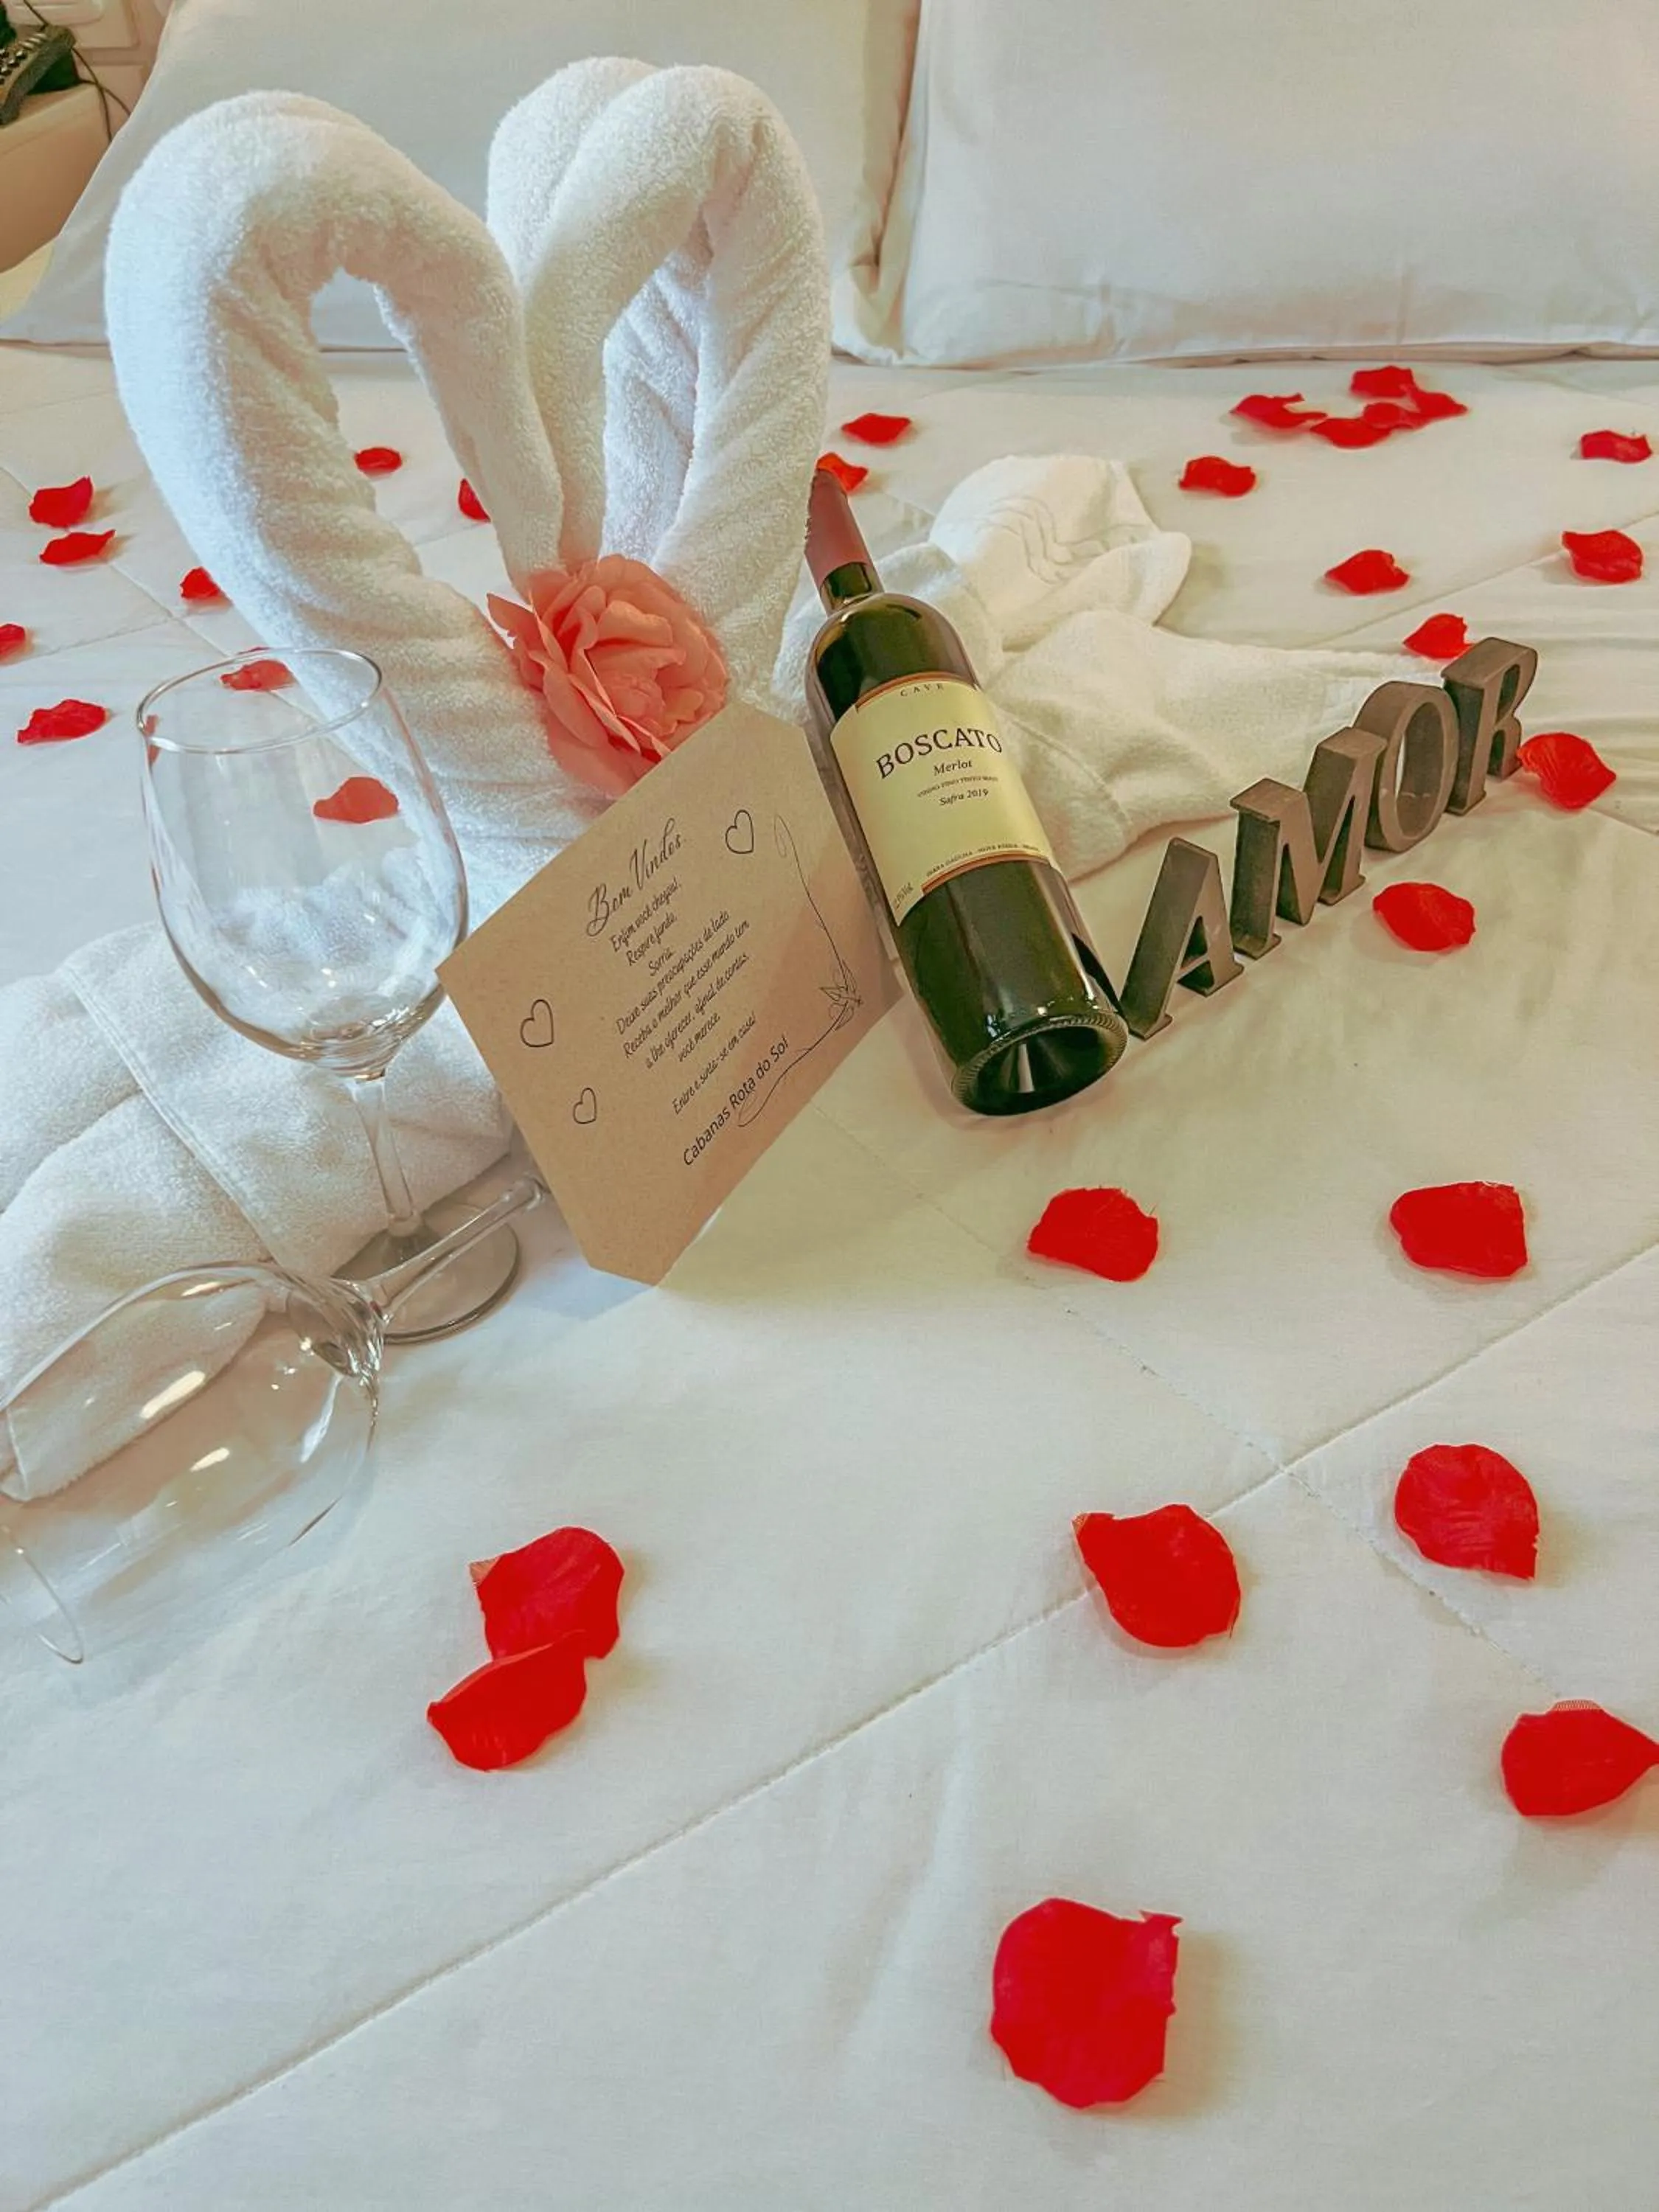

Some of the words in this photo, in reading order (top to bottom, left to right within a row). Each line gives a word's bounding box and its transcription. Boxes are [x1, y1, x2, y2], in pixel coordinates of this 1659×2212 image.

[876, 727, 1003, 779] BOSCATO
[933, 759, 973, 776] Merlot
[938, 794, 964, 807] Safra
[967, 787, 990, 799] 2019
[1121, 636, 1538, 1042] AMOR
[616, 1006, 641, 1035] Deixe
[640, 989, 658, 1012] suas
[656, 937, 705, 997] preocupações
[703, 926, 714, 942] de
[622, 1024, 653, 1059] Receba
[651, 1018, 659, 1029] o
[657, 990, 682, 1023] melhor
[683, 975, 698, 998] que
[696, 958, 713, 980] esse
[711, 933, 736, 964] mundo
[650, 1043, 667, 1062] lhe
[695, 981, 717, 1015] afinal
[715, 974, 726, 992] de
[672, 1085, 695, 1116] Entre
[693, 1079, 701, 1090] e
[728, 1034, 740, 1051] em
[678, 1037, 695, 1062] você
[683, 1106, 731, 1166] Cabanas
[728, 1076, 757, 1110] Rota
[755, 1058, 771, 1080] do
[770, 1032, 790, 1063] Sol
